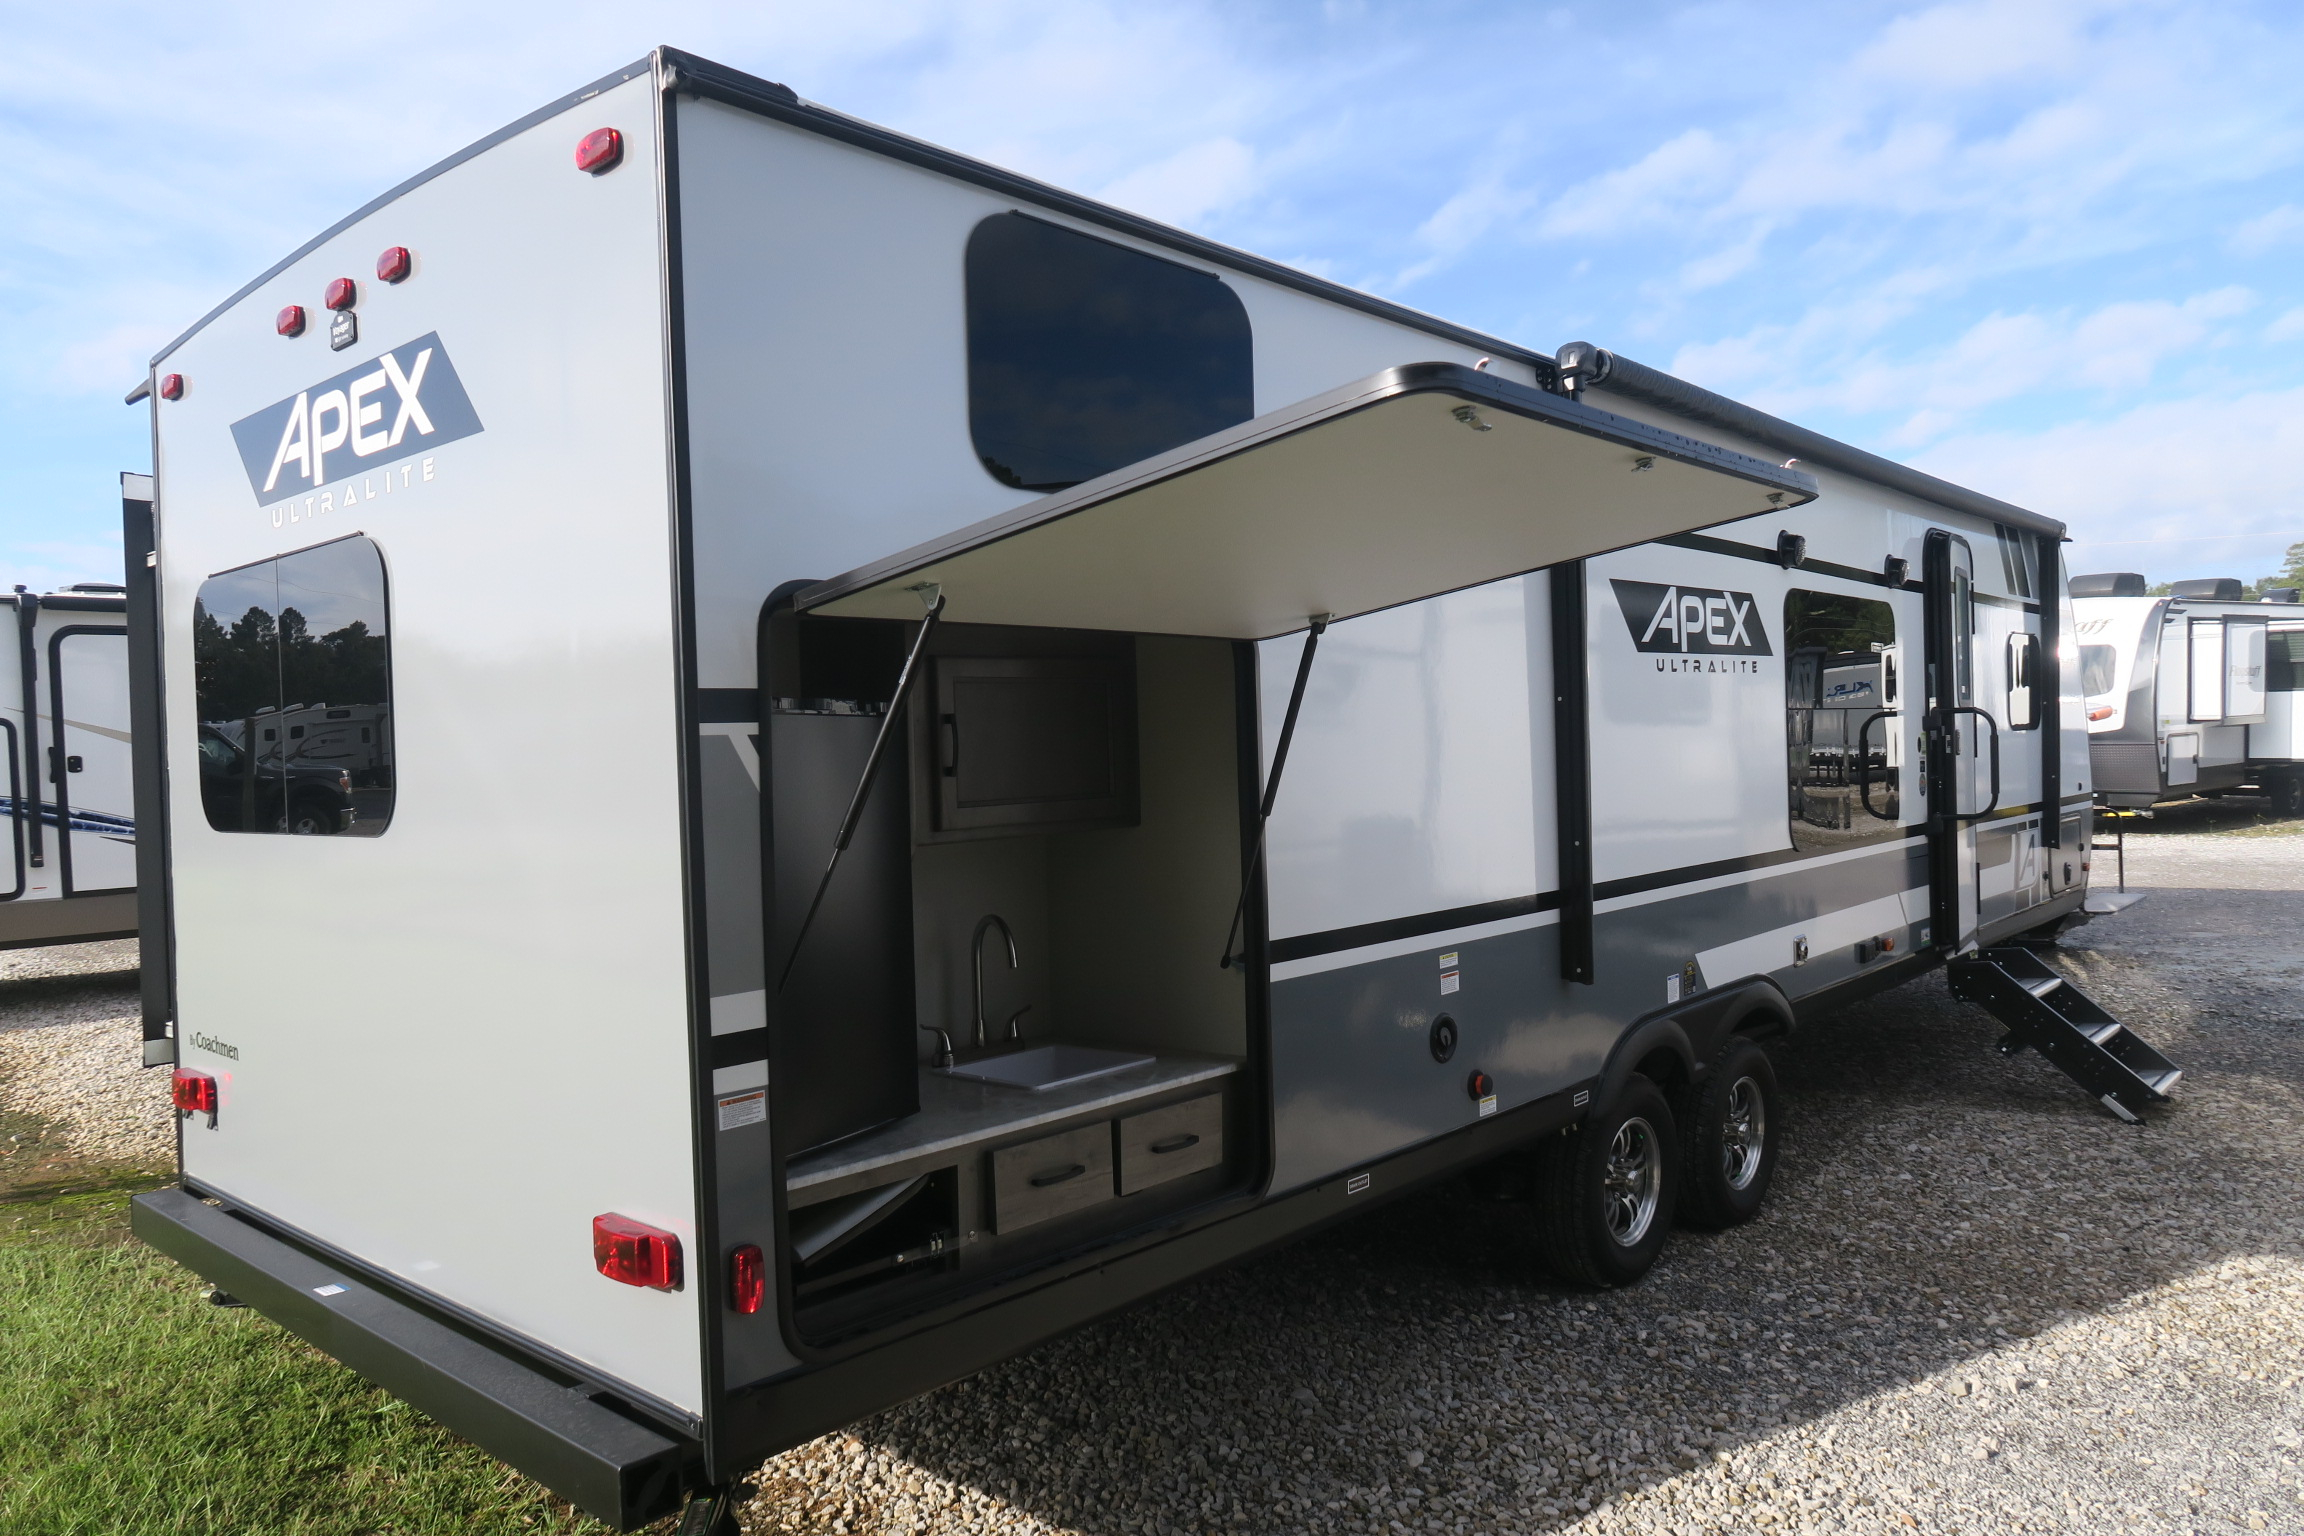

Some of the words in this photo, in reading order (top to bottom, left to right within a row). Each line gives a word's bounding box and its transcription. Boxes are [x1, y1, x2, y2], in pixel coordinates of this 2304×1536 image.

[263, 347, 436, 493] APEX
[271, 456, 436, 529] ULTRALITE
[1641, 586, 1752, 653] APEX
[1656, 658, 1758, 674] ULTRALITE
[196, 1031, 239, 1061] Coachmen
